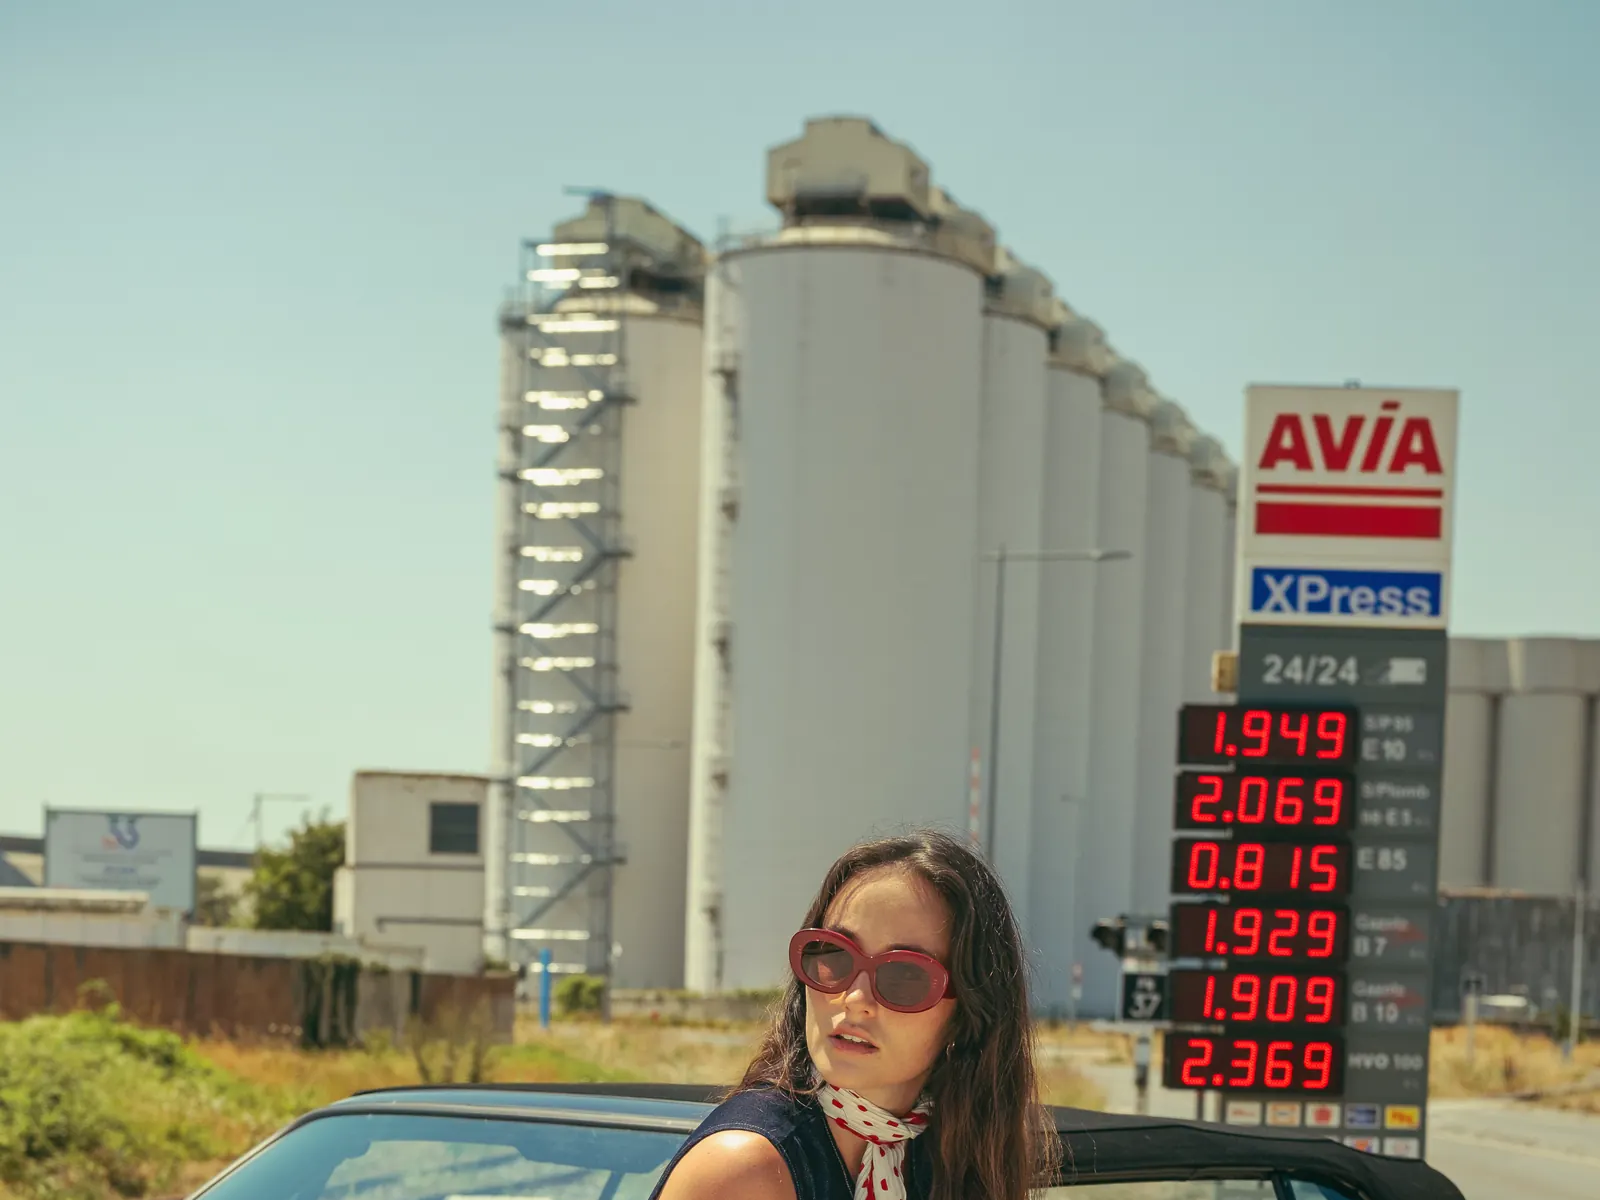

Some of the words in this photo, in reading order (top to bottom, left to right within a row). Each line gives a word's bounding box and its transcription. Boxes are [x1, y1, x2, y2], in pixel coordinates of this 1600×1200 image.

[1261, 574, 1432, 616] XPress
[1263, 654, 1358, 685] 24/24
[1214, 710, 1347, 759] 1.949
[1191, 775, 1343, 825] 2.069
[1187, 842, 1338, 892] 0.815
[1205, 908, 1337, 957] 1.929
[1203, 974, 1335, 1023] 1.909
[1181, 1039, 1333, 1089] 2.369
